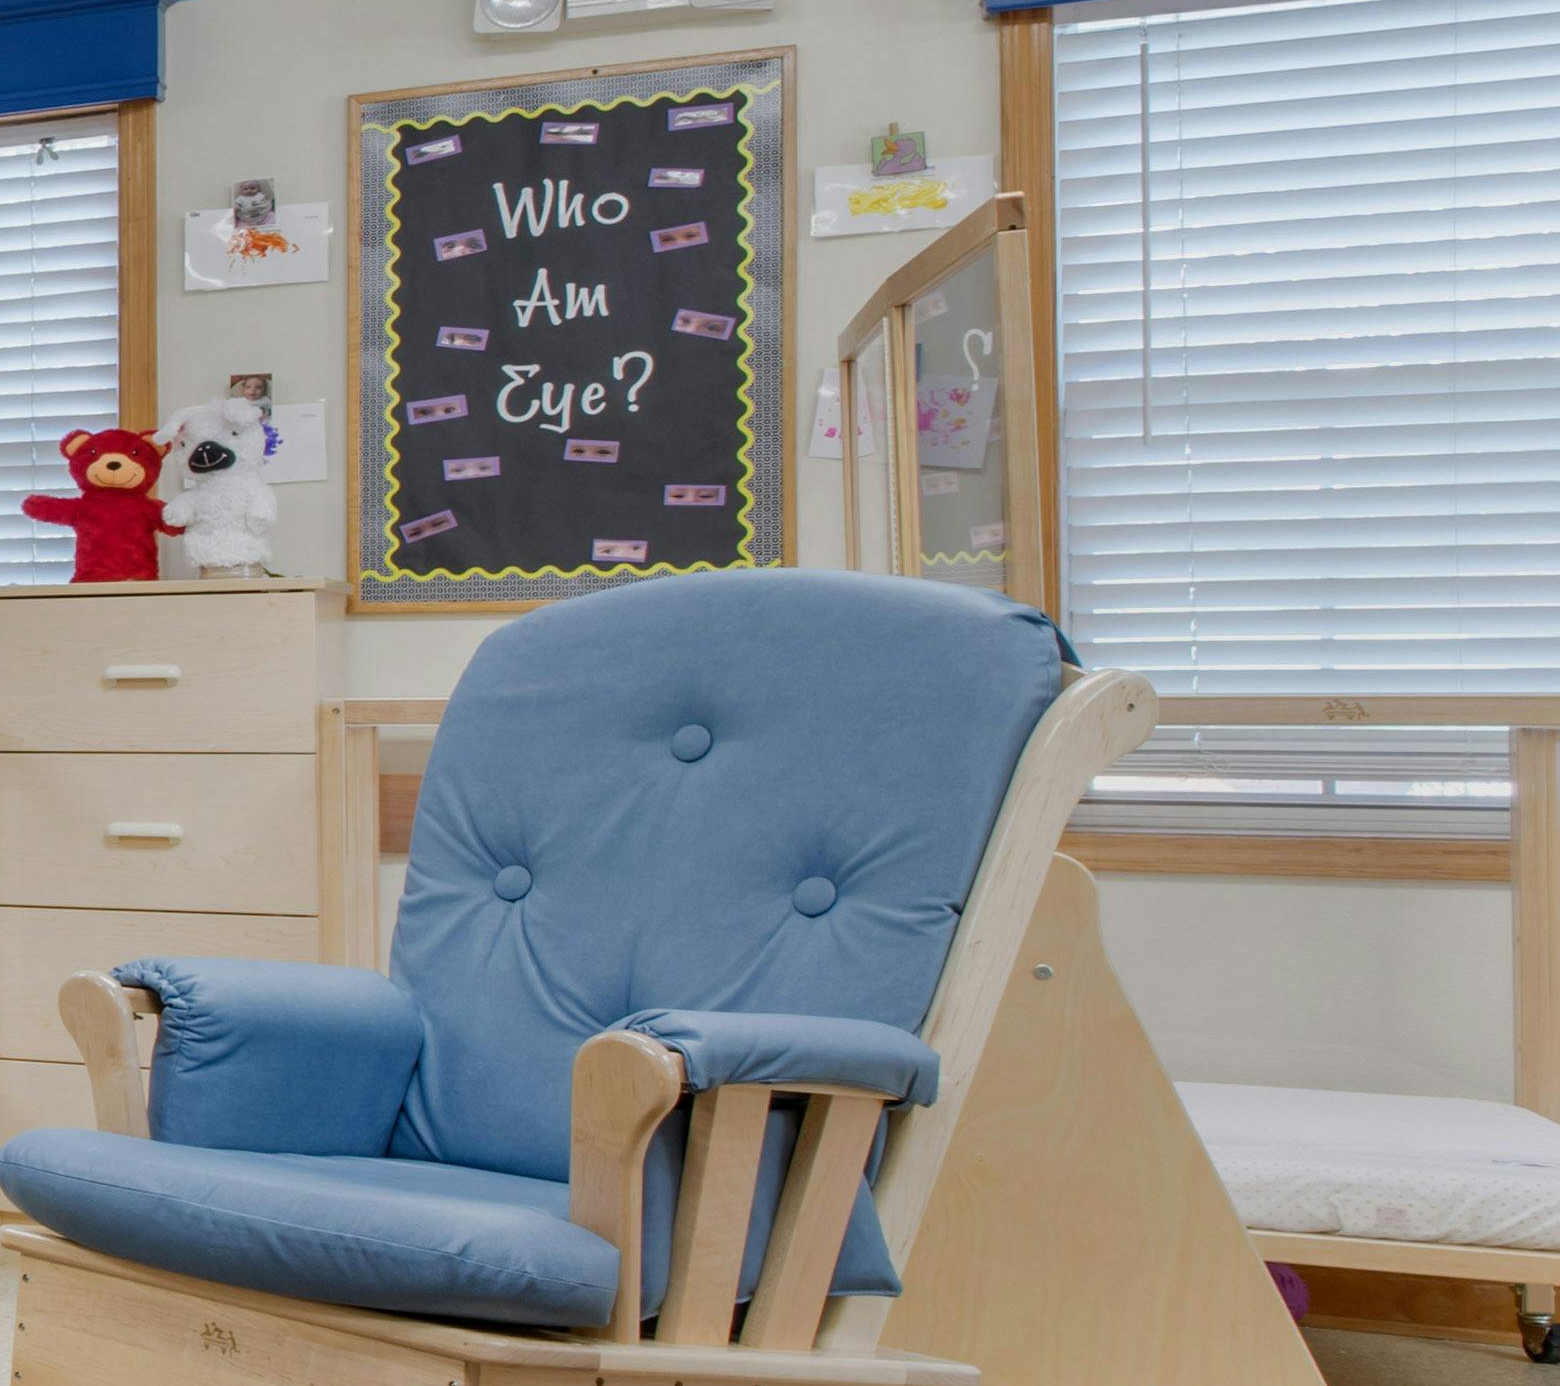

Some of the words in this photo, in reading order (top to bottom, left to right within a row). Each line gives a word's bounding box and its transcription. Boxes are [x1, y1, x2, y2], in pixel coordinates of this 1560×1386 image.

[493, 178, 629, 238] Who
[513, 268, 609, 327] Am
[496, 351, 653, 433] Eye?
